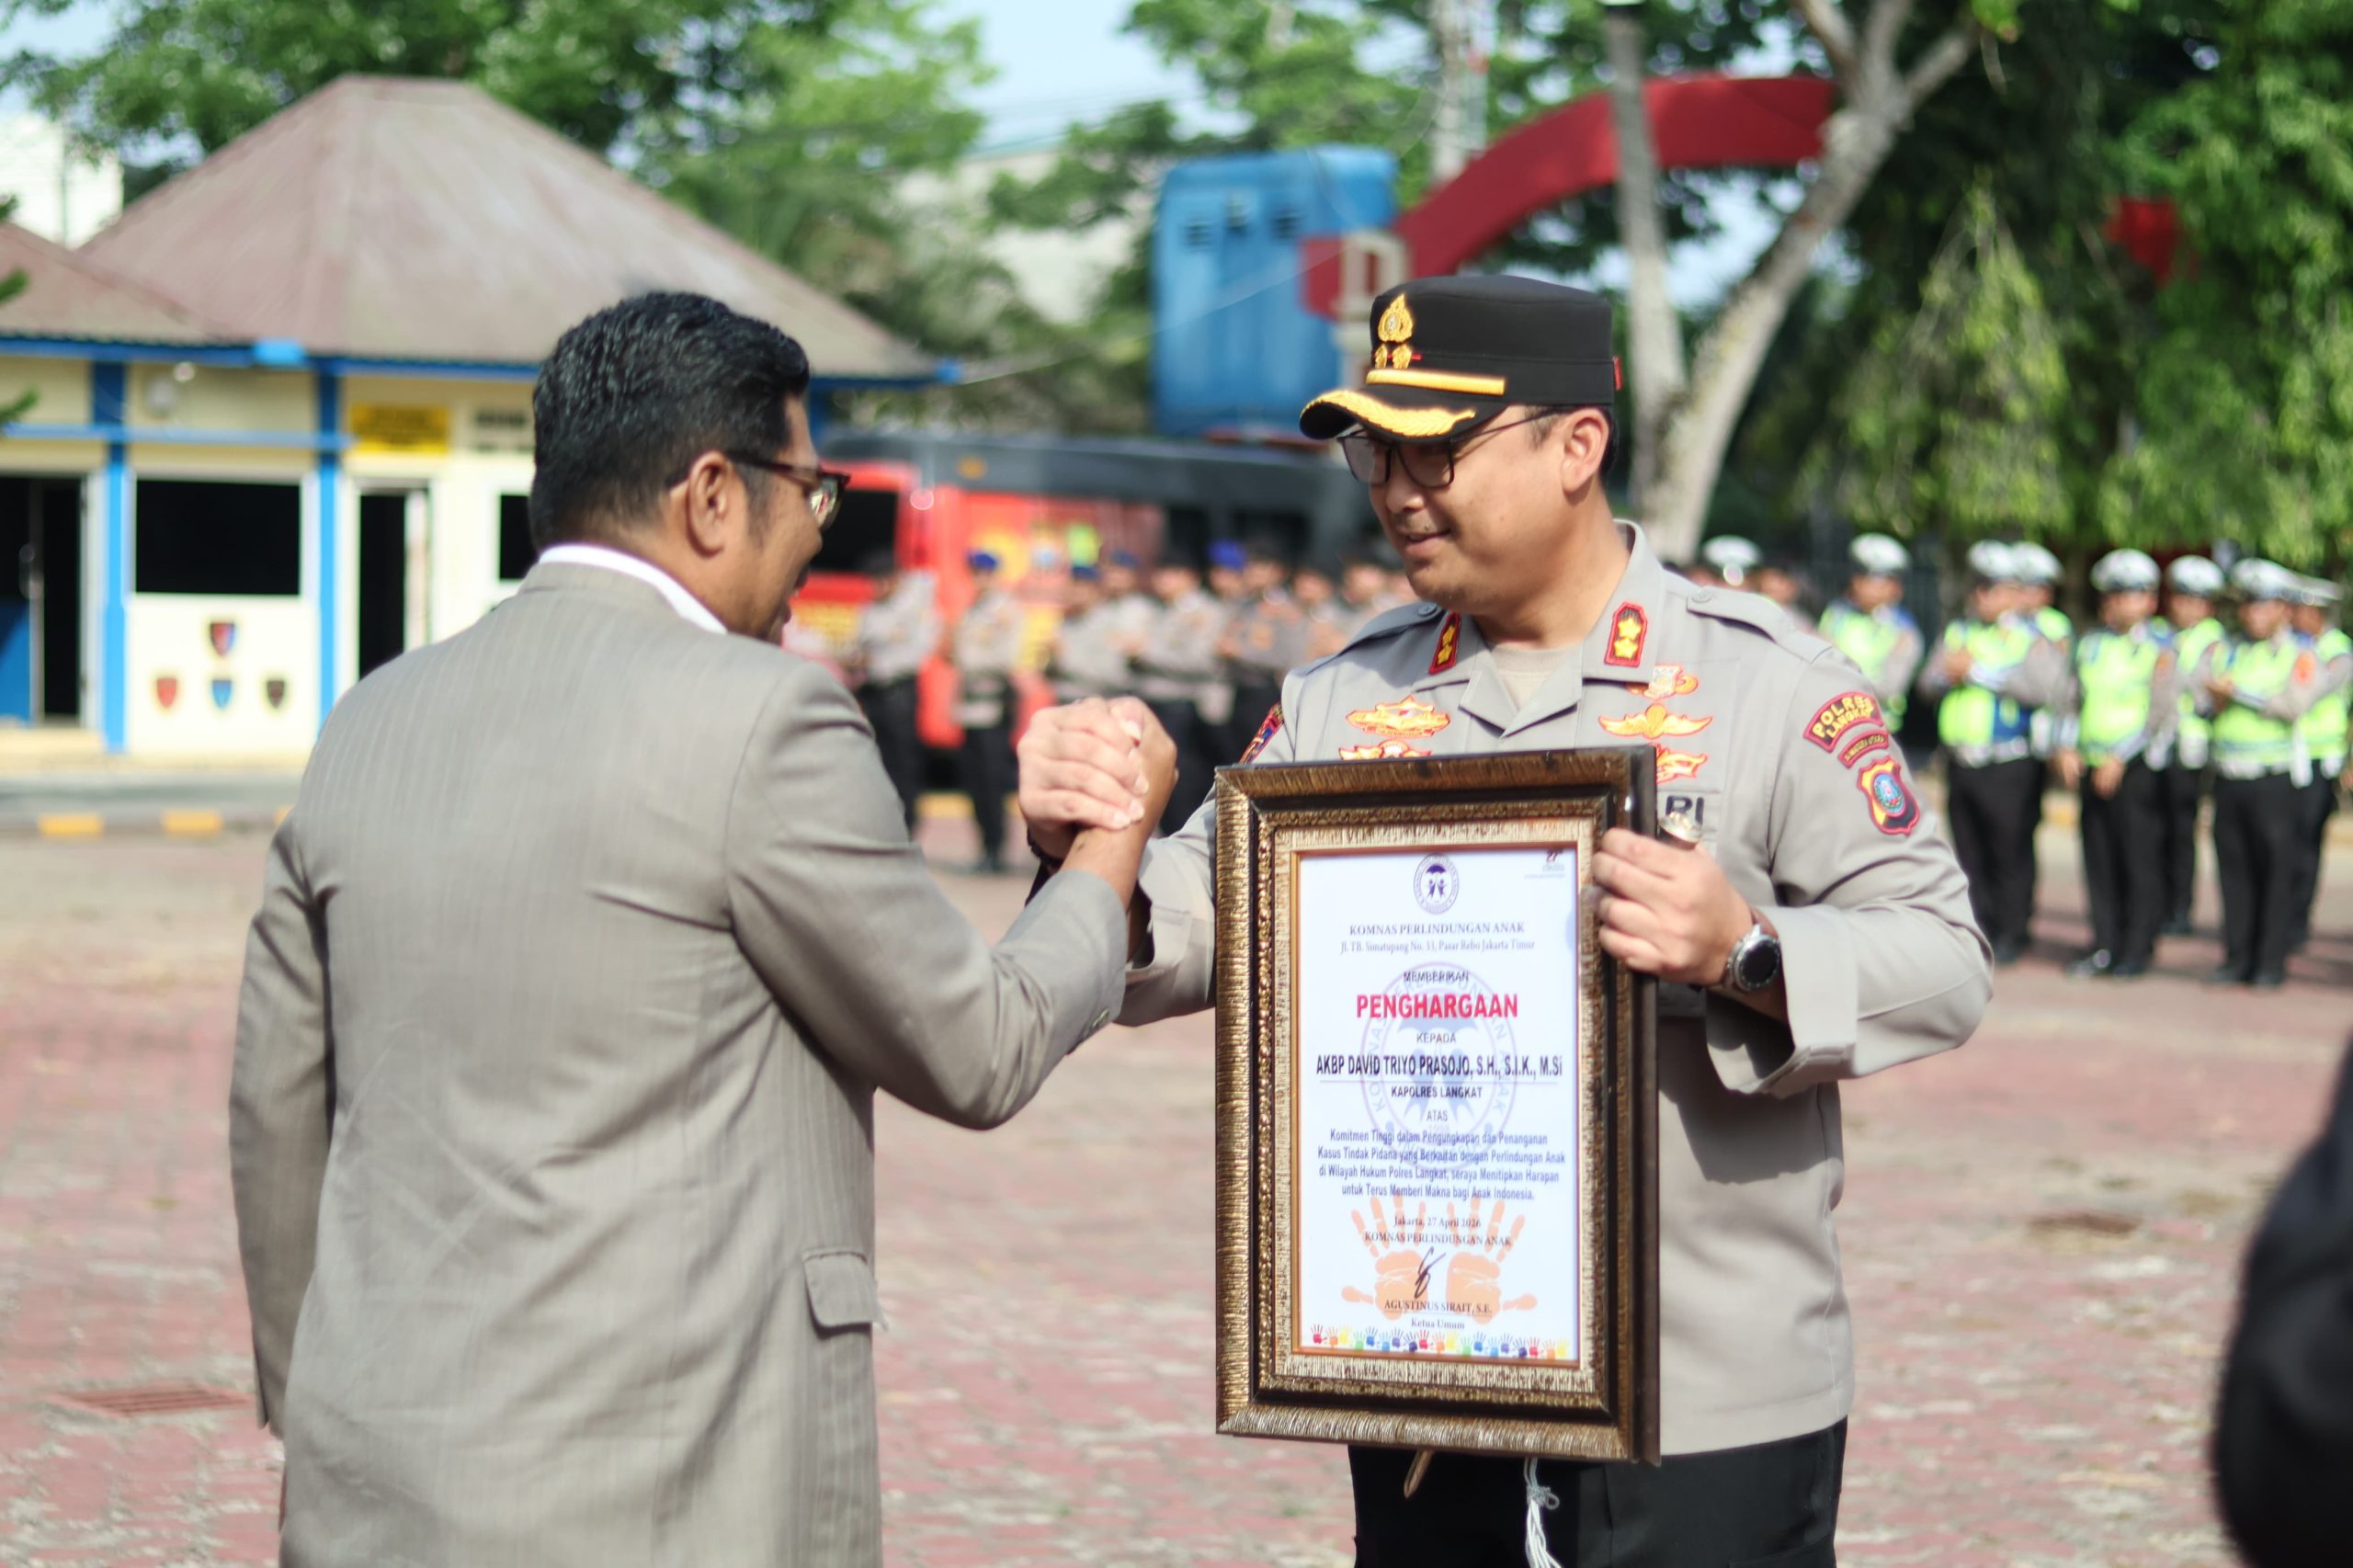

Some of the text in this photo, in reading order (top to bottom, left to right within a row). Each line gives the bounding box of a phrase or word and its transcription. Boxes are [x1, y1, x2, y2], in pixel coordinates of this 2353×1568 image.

[1349, 922, 1525, 936] KOMNAS PERLINDUNGAN ANAK
[1482, 938, 1508, 952] Jakarta
[1404, 970, 1469, 983] MEMBERIKAN
[1357, 994, 1518, 1018] PENGHARGAAN
[1416, 1032, 1457, 1043] KEPADA
[1316, 1055, 1563, 1080] AKBP DAVID TRIYO PRASOJO, S.H., S.I.K., M.Si
[1392, 1086, 1483, 1099] KAPOLRES LANGKAT
[1427, 1110, 1449, 1122] ATAS
[1330, 1129, 1548, 1148] Komitmen Tinggi dalam Pengungkapan dan Penanganan
[1318, 1145, 1566, 1166] Kasus Tindak Pidana yang Berkaitan dengan Perlindungan Anak
[1319, 1165, 1560, 1185] di Wilayah Hukum Polres Langkat, seraya Menitipkan Harapan
[1342, 1183, 1535, 1201] untuk Terus Memberi Makna bagi Anak Indonesia.
[1393, 1216, 1425, 1228] Jakarta,
[1427, 1217, 1437, 1226] 27
[1438, 1218, 1460, 1229] April
[1365, 1232, 1512, 1246] KOMNAS PERLINDUNGAN ANAK
[1384, 1300, 1493, 1314] AGUSTINUS SIRAIT, S.E.
[1411, 1318, 1465, 1329] Ketua Umum
